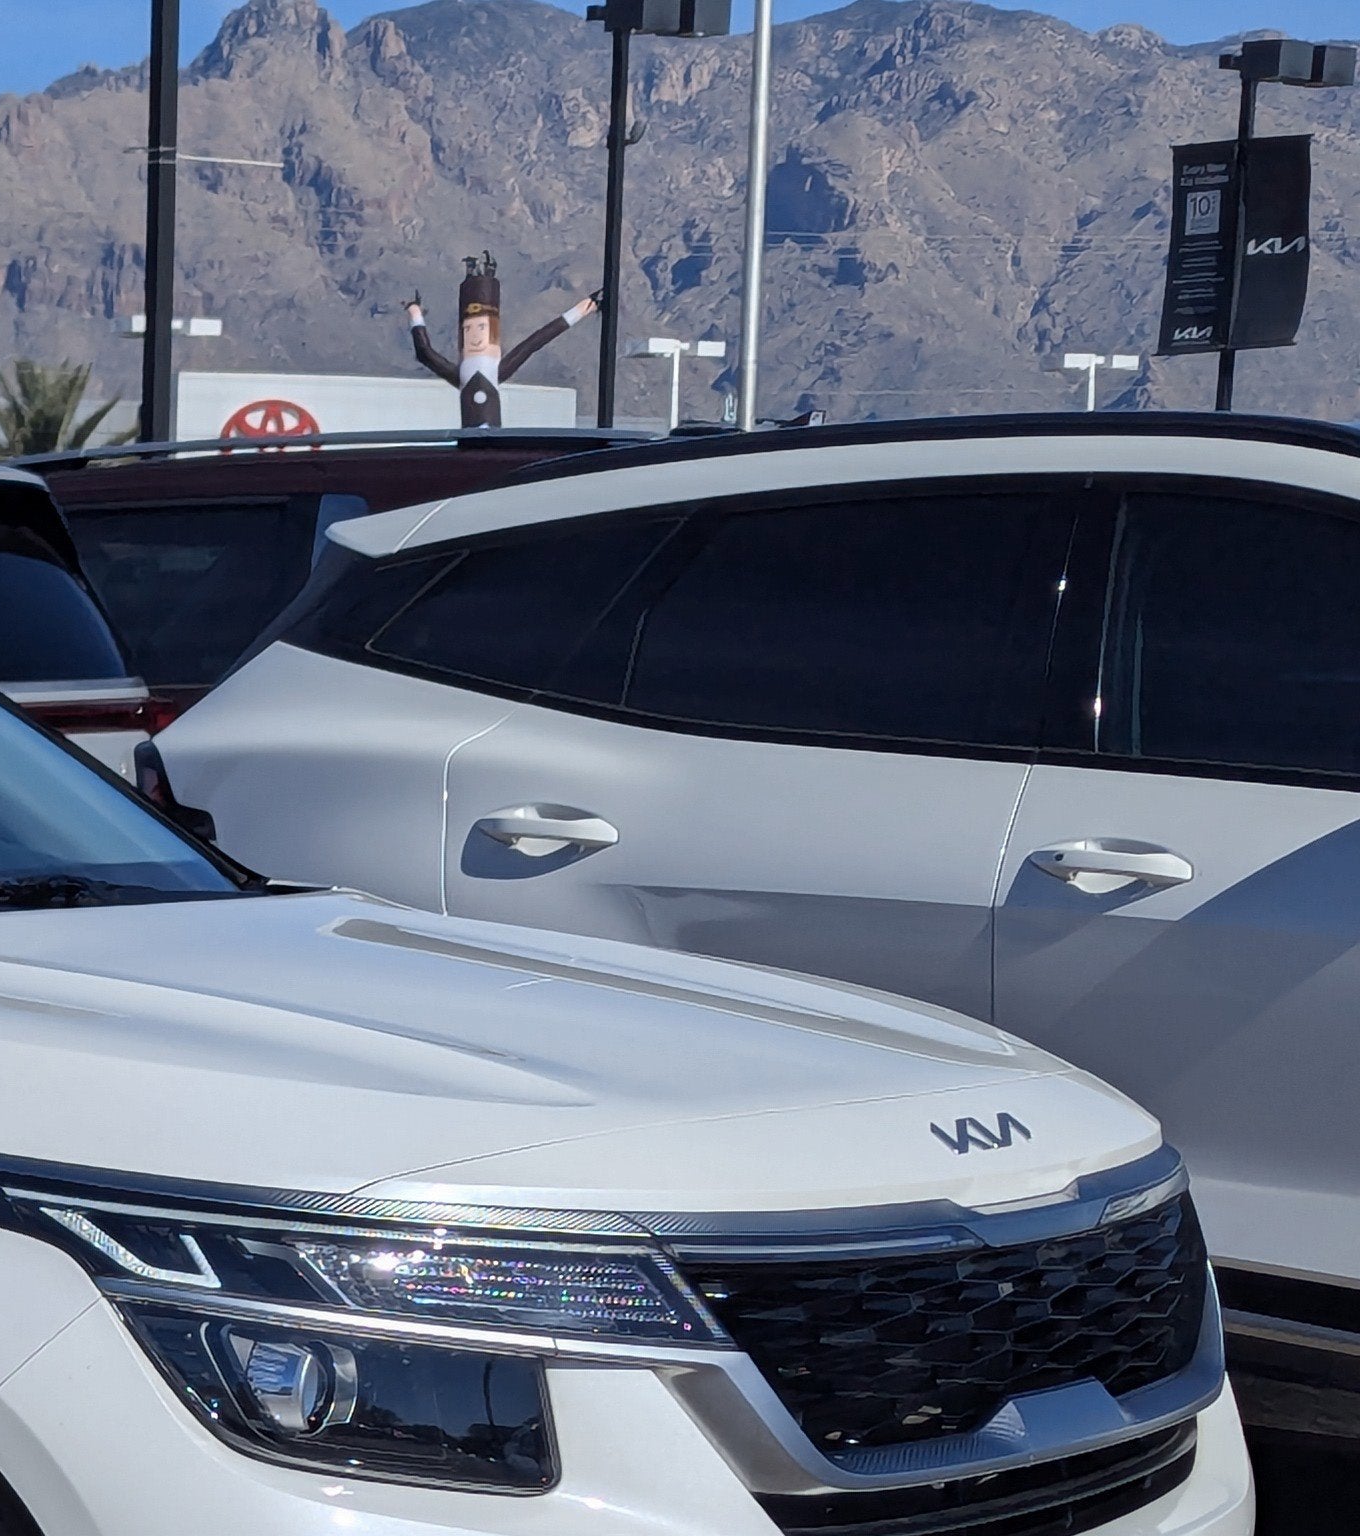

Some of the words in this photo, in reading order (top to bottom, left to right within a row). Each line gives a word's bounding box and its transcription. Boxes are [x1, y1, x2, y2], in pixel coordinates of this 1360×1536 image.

[1247, 236, 1306, 255] KIA
[1173, 325, 1213, 340] KIA
[930, 1112, 1032, 1155] KIA
